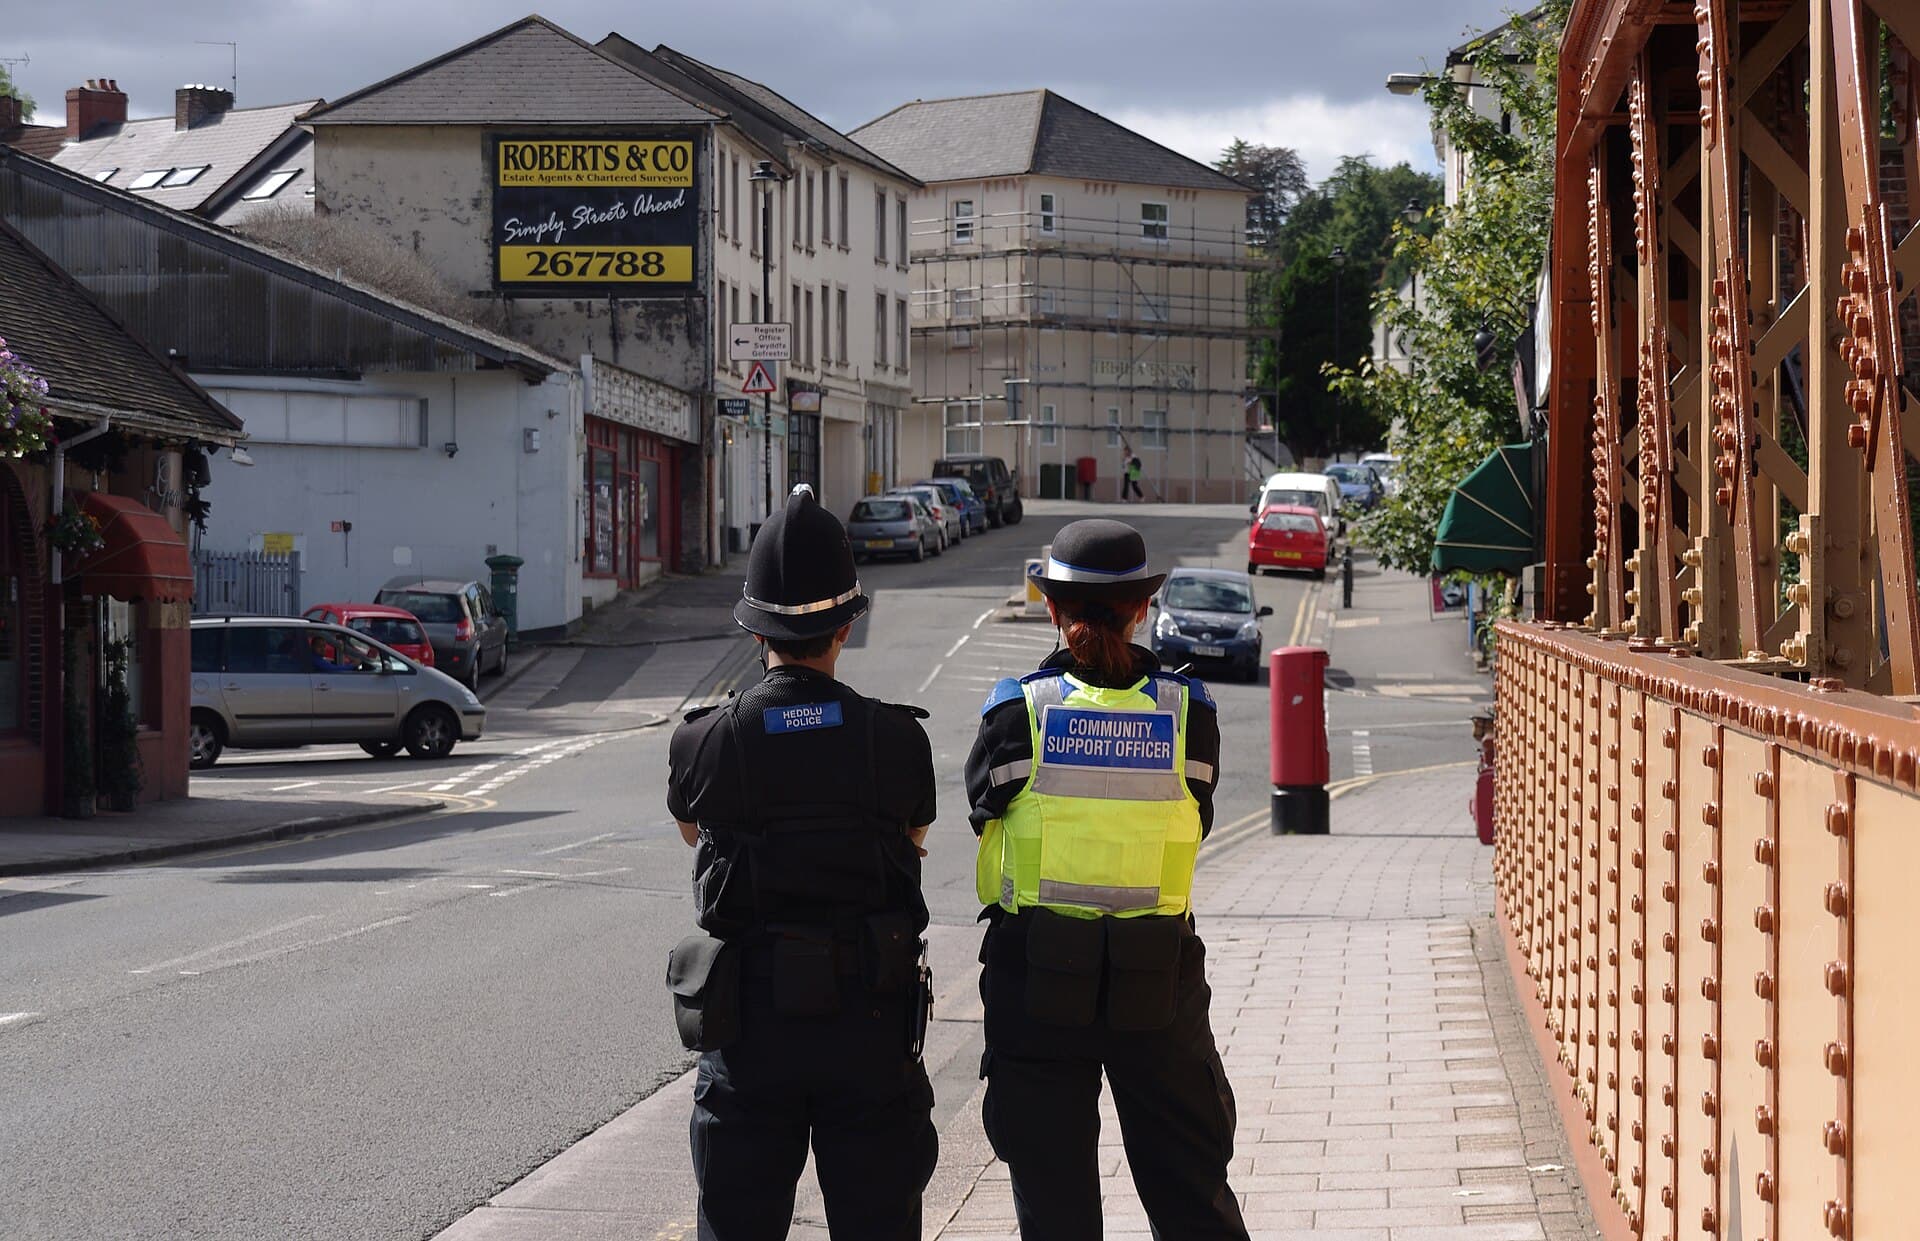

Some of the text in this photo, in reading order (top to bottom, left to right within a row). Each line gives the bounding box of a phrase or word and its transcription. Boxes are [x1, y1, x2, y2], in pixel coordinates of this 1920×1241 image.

[503, 144, 689, 172] ROBERTS & CO
[503, 173, 689, 185] Estate Agents & Chartered Surveyors
[503, 188, 685, 243] Simply Streets Ahead
[526, 250, 666, 278] 267788
[783, 707, 823, 719] HEDDLU
[786, 716, 822, 728] POLICE
[1068, 718, 1153, 739] COMMUNITY
[1047, 735, 1170, 759] SUPPORT OFFICER
